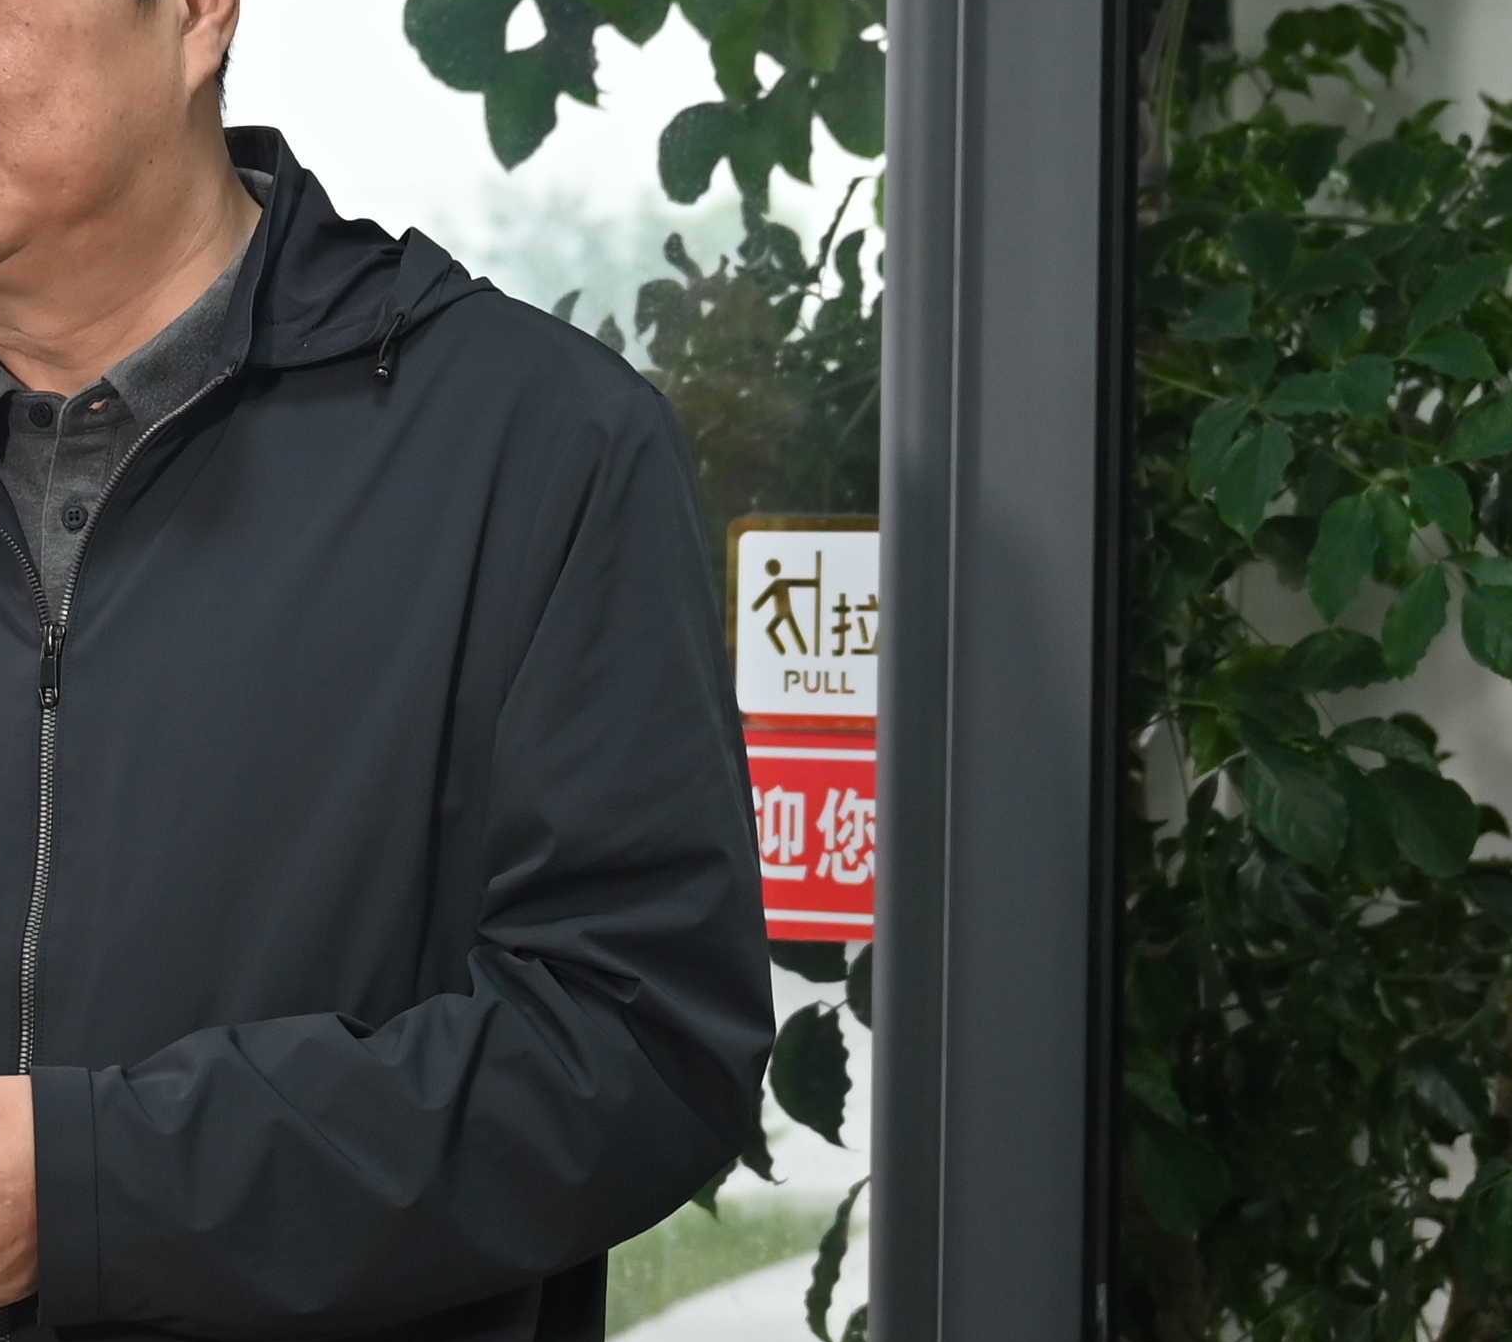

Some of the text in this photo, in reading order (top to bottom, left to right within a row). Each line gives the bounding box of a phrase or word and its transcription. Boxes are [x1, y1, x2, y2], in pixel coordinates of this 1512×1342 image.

[831, 592, 880, 657] 拉
[783, 669, 856, 695] PULL
[755, 786, 876, 885] 迎您
